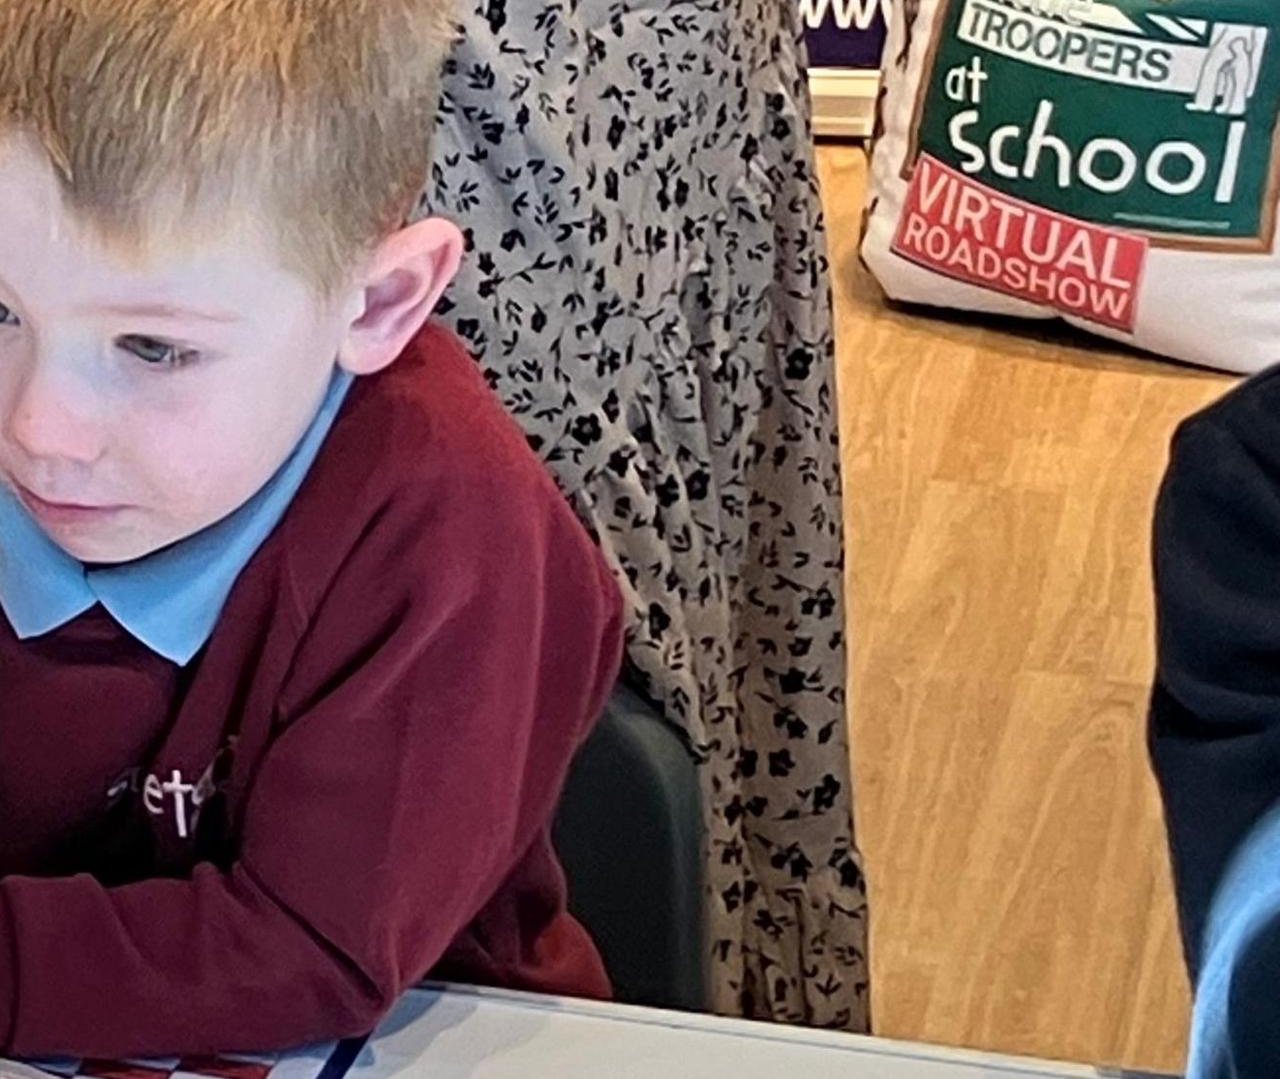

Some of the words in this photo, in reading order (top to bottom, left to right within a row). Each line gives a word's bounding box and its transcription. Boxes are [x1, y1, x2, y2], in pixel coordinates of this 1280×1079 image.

[945, 56, 989, 104] at
[967, 3, 1173, 83] TROOPERS
[903, 213, 1129, 319] ROADSHOW
[920, 162, 1131, 289] VIRTUAL
